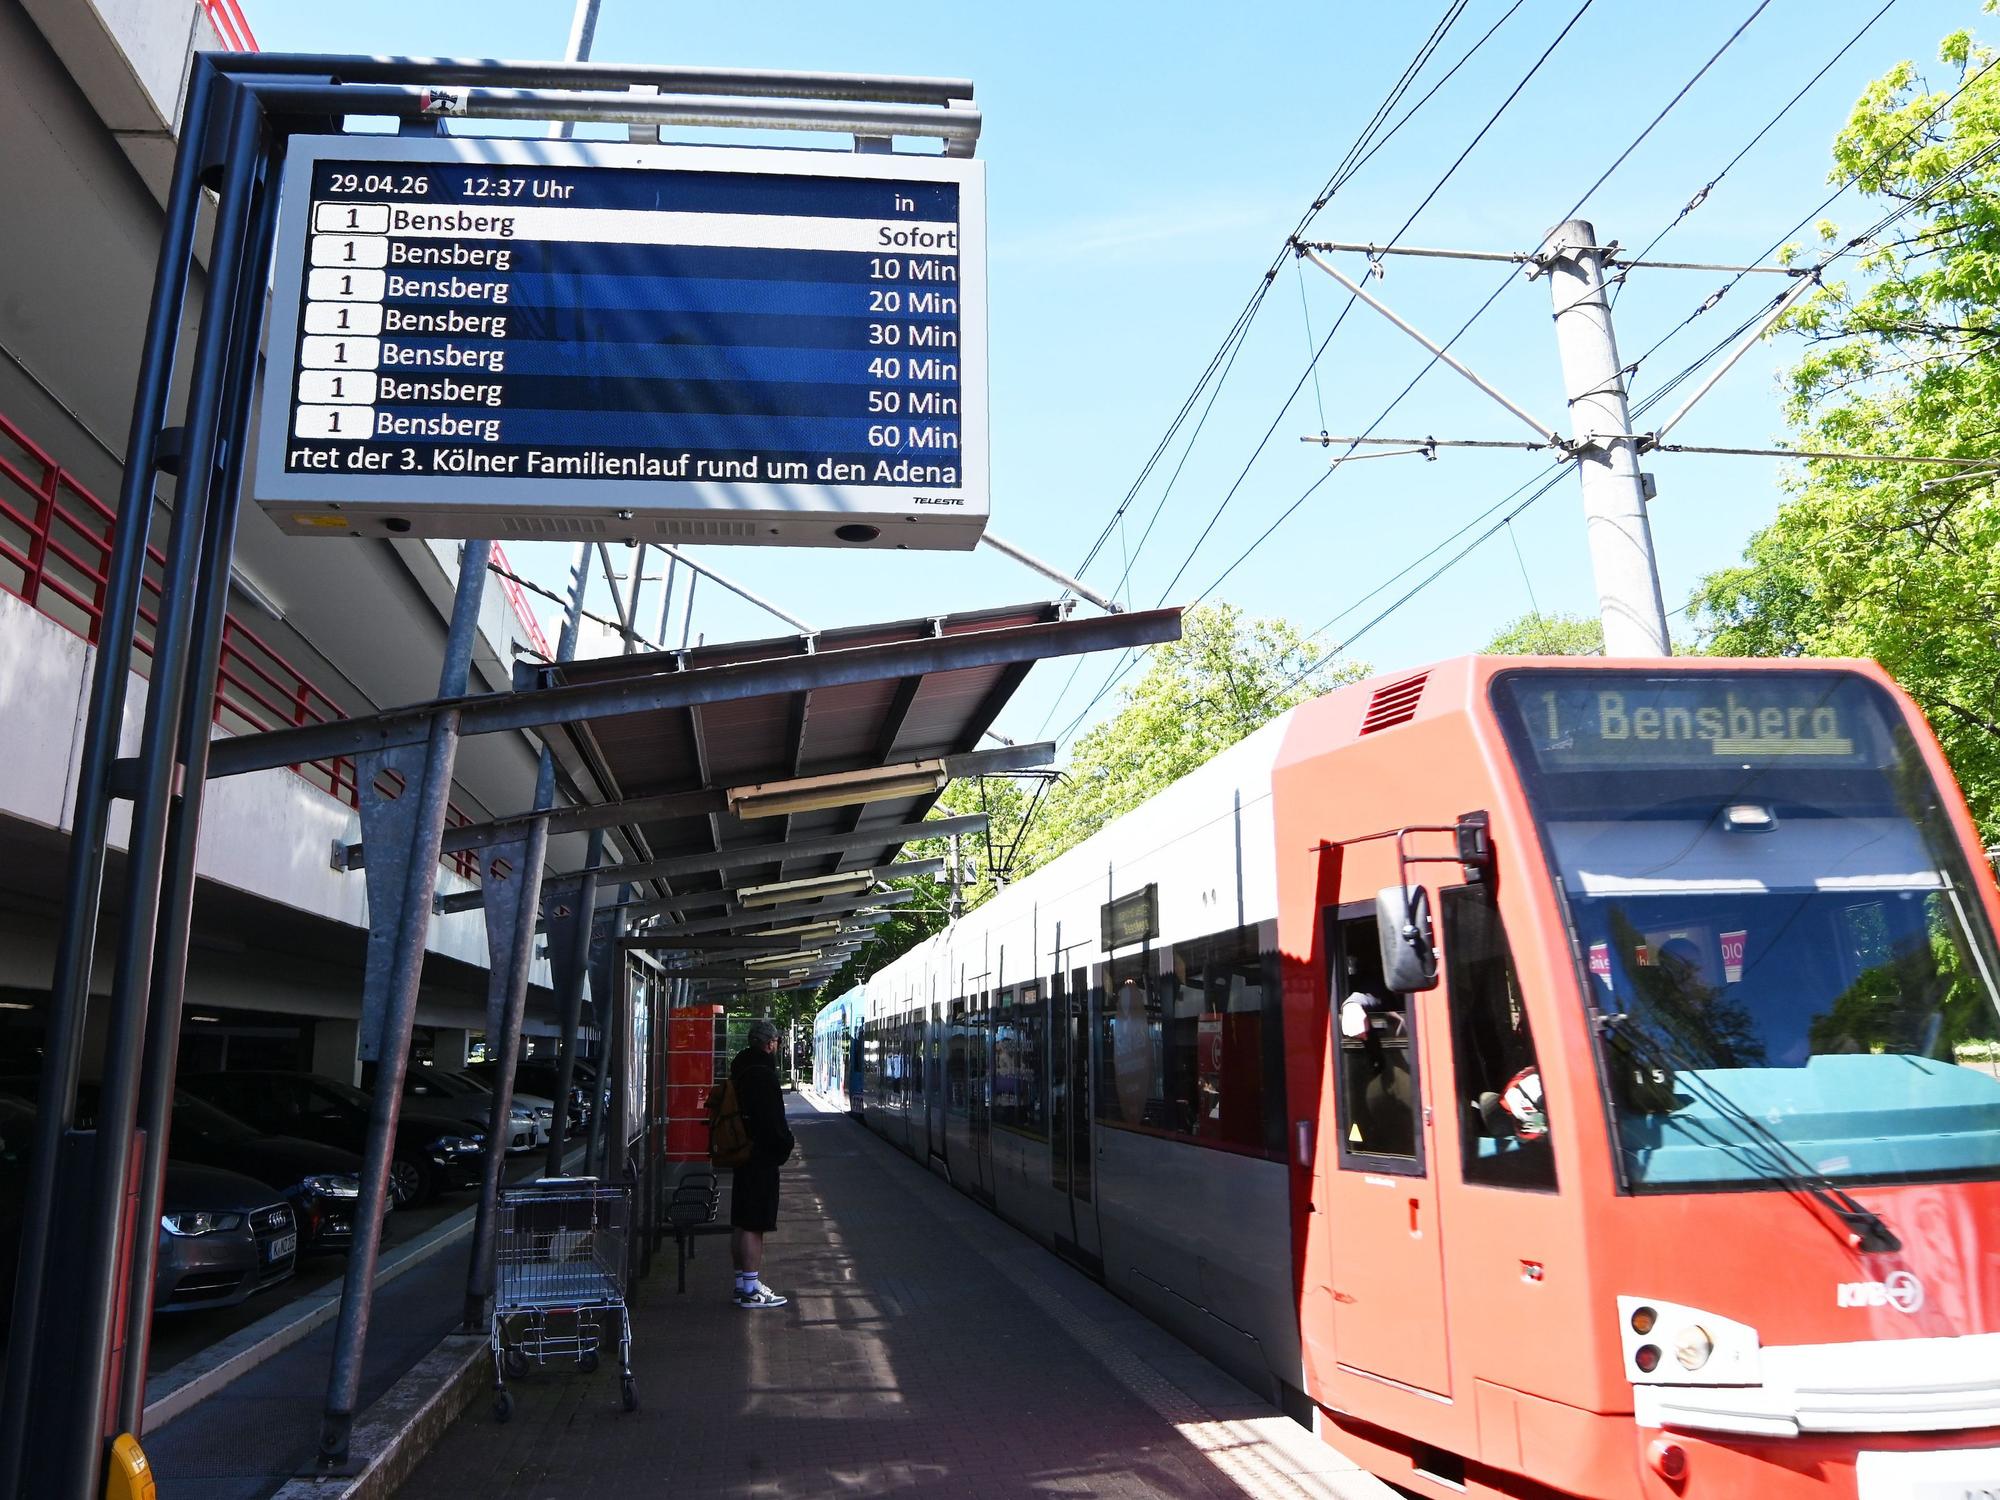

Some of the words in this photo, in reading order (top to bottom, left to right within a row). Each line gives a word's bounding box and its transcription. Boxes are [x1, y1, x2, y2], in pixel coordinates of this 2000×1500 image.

[330, 174, 428, 195] 29.04.26
[462, 177, 526, 197] 12:37
[532, 180, 575, 199] Uhr
[895, 193, 915, 212] in
[346, 208, 359, 229] 1
[393, 209, 515, 237] Bensberg
[878, 225, 957, 249] Sofort
[343, 241, 357, 262] 1
[391, 243, 512, 270] Bensberg
[870, 259, 901, 280] 10
[908, 259, 957, 281] Min
[339, 275, 353, 296] 1
[388, 276, 509, 303] Bensberg
[869, 291, 901, 312] 20
[908, 292, 957, 314] Min
[336, 309, 350, 330] 1
[385, 310, 507, 338] Bensberg
[868, 324, 901, 345] 30
[908, 325, 957, 347] Min
[333, 343, 347, 363] 1
[383, 344, 504, 372] Bensberg
[867, 357, 901, 379] 40
[908, 358, 957, 381] Min
[330, 377, 344, 398] 1
[380, 378, 502, 406] Bensberg
[868, 391, 901, 413] 50
[908, 392, 958, 415] Min
[327, 411, 342, 432] 1
[377, 412, 501, 441] Bensberg
[868, 425, 901, 447] 60
[908, 426, 958, 448] Min
[290, 447, 339, 469] rtet
[347, 446, 393, 470] der
[399, 448, 424, 471] 3.
[433, 448, 520, 474] Kölner
[527, 451, 691, 479] Familienlauf
[696, 455, 758, 479] rund
[767, 462, 808, 480] um
[816, 457, 866, 482] den
[873, 459, 957, 484] Adena
[912, 496, 965, 506] TELESTE
[1542, 690, 1560, 740] 1
